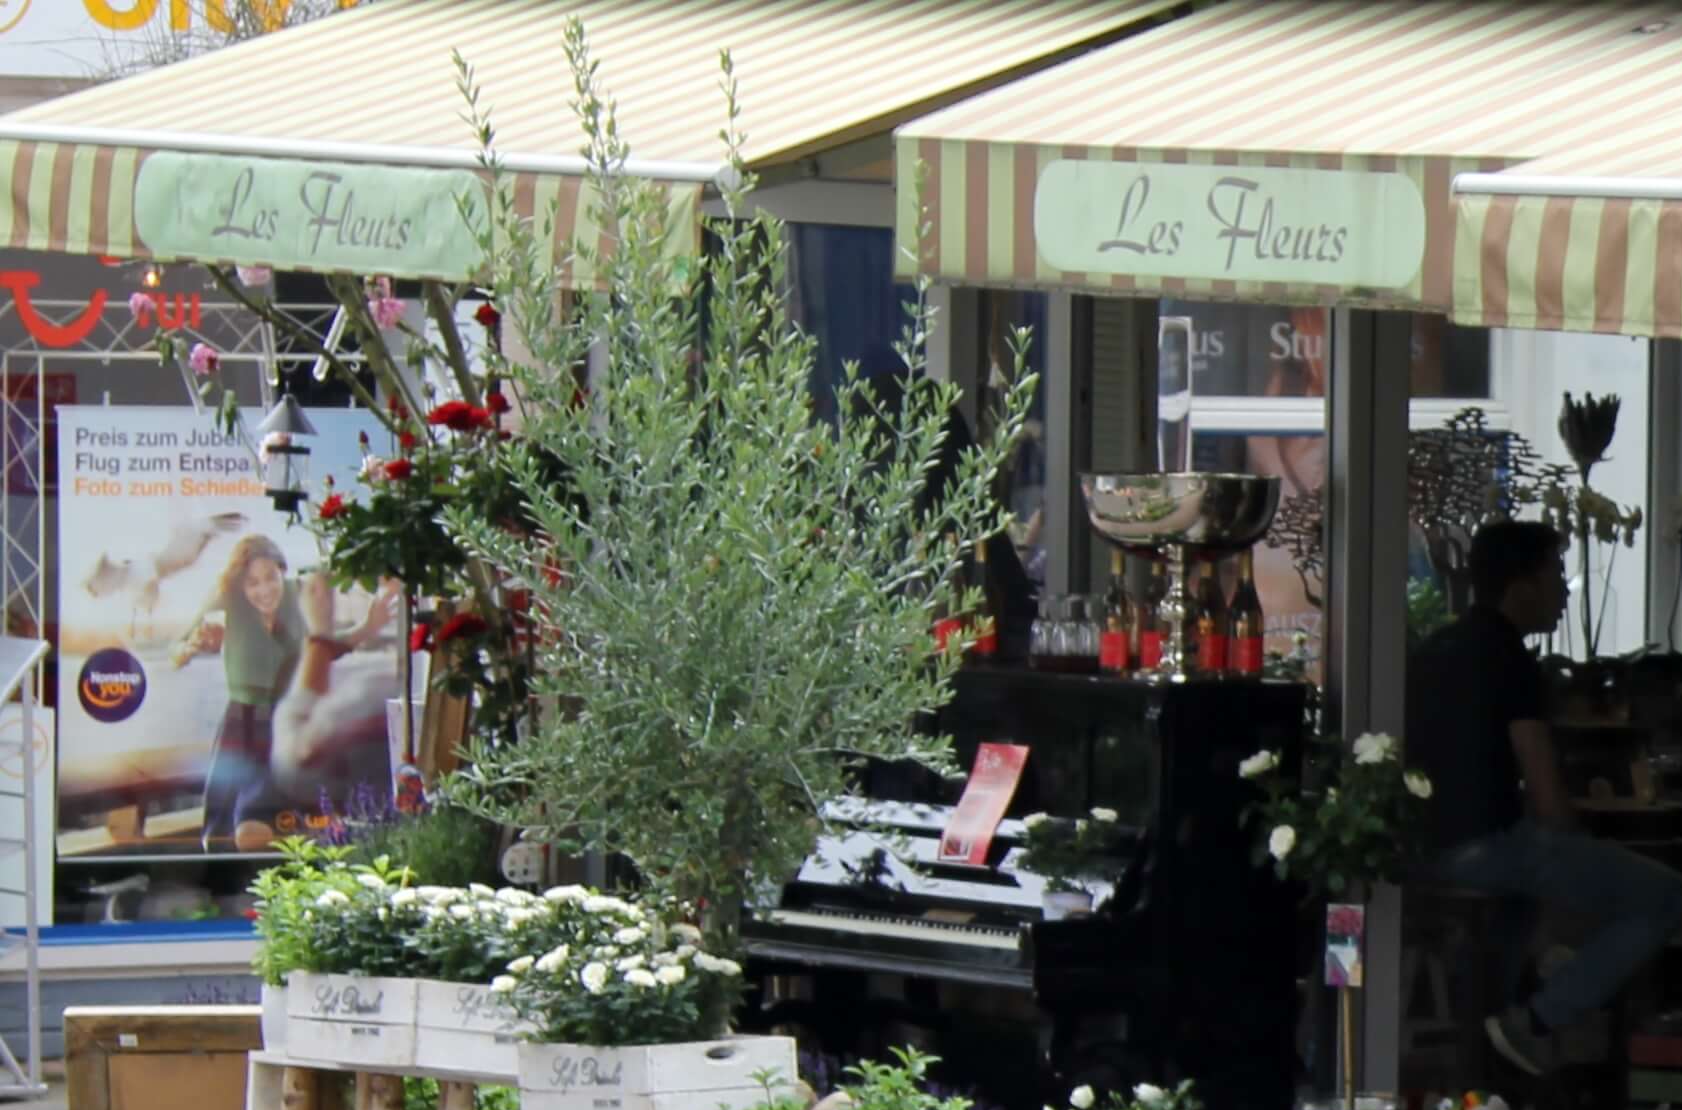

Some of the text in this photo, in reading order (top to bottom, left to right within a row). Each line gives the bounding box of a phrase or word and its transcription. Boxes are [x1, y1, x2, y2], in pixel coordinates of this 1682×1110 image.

[211, 166, 412, 257] Les Fleurs
[1096, 173, 1348, 272] Les Fleurs
[75, 427, 242, 448] Preis zum Jubel
[75, 452, 120, 475] Flug
[128, 457, 171, 472] zum
[75, 476, 123, 497] Foto
[130, 481, 173, 497] zum
